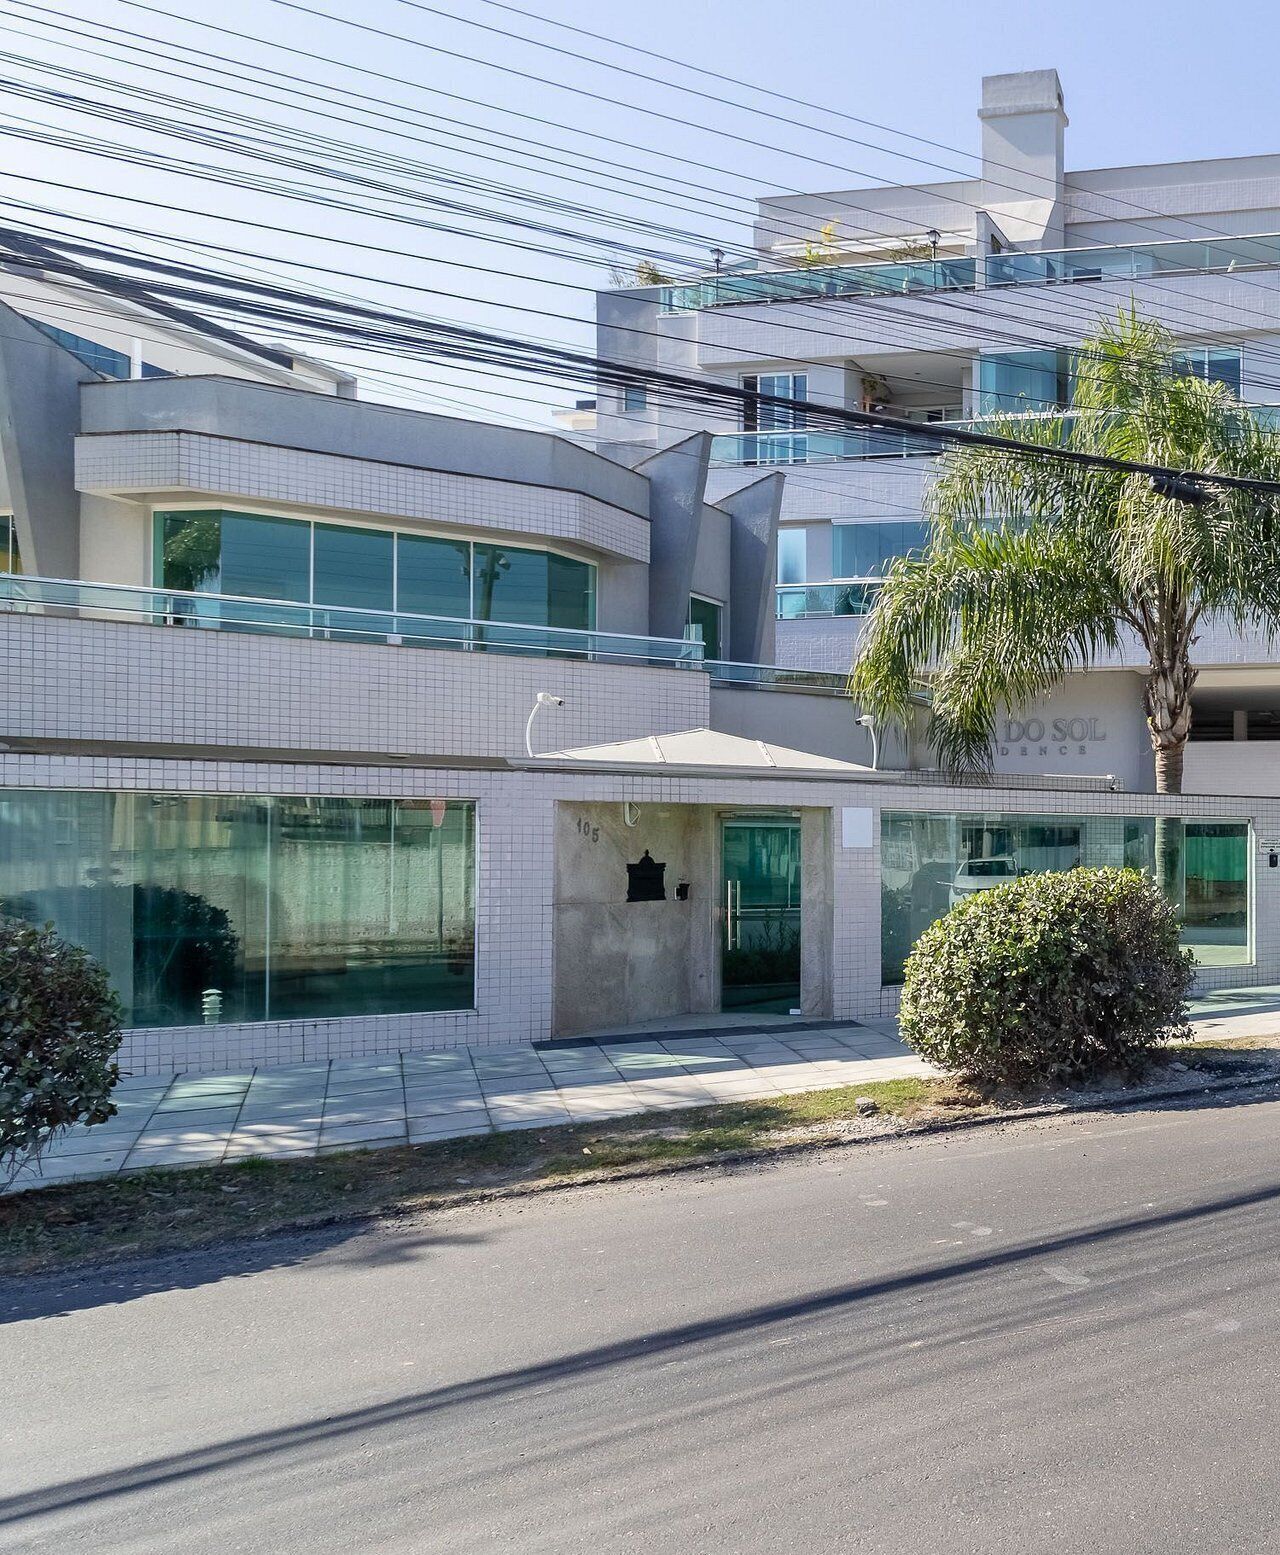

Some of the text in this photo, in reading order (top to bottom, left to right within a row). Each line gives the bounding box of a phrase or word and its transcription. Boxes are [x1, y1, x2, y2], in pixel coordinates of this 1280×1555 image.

[1003, 718, 1045, 742] DO
[1052, 717, 1107, 742] SOL
[1001, 744, 1087, 757] DENCE
[576, 817, 600, 843] 105
